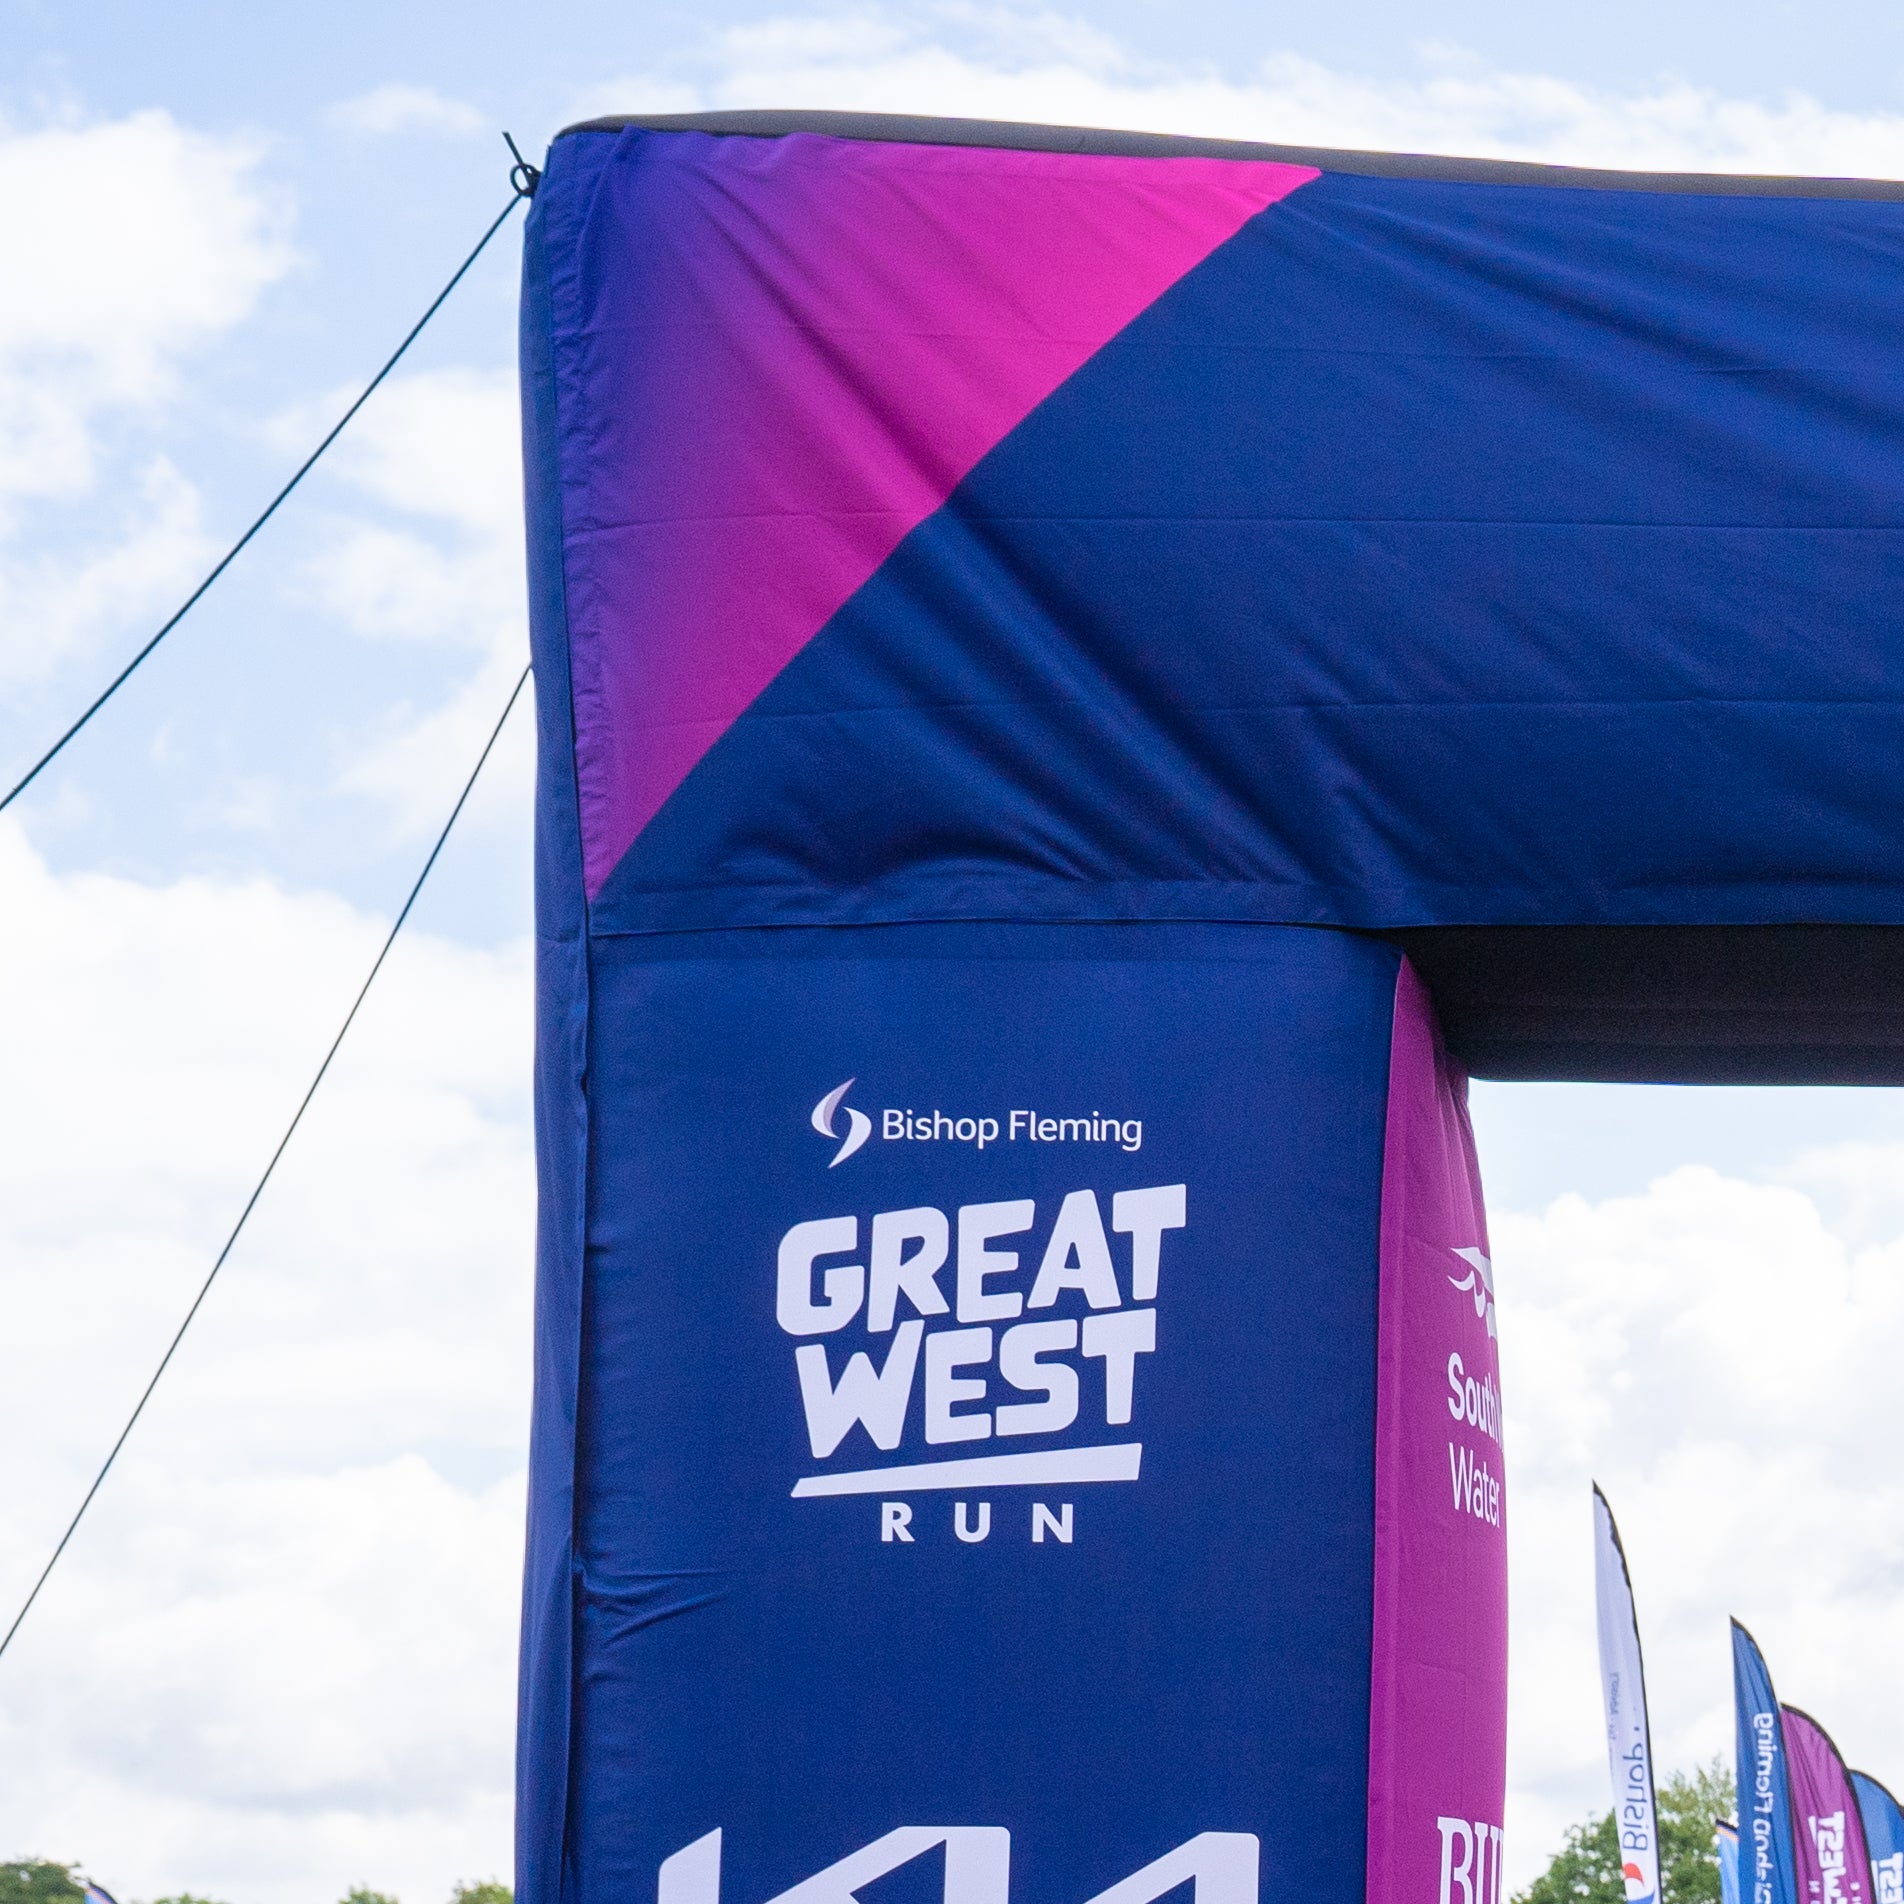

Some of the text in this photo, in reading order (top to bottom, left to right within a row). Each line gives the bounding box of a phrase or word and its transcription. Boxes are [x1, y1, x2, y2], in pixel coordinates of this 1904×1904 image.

[883, 1109, 1141, 1151] Bishop Fleming
[777, 1184, 1186, 1343] GREAT
[795, 1308, 1157, 1459] WEST
[882, 1502, 1073, 1543] RUN
[1449, 1442, 1501, 1528] Water
